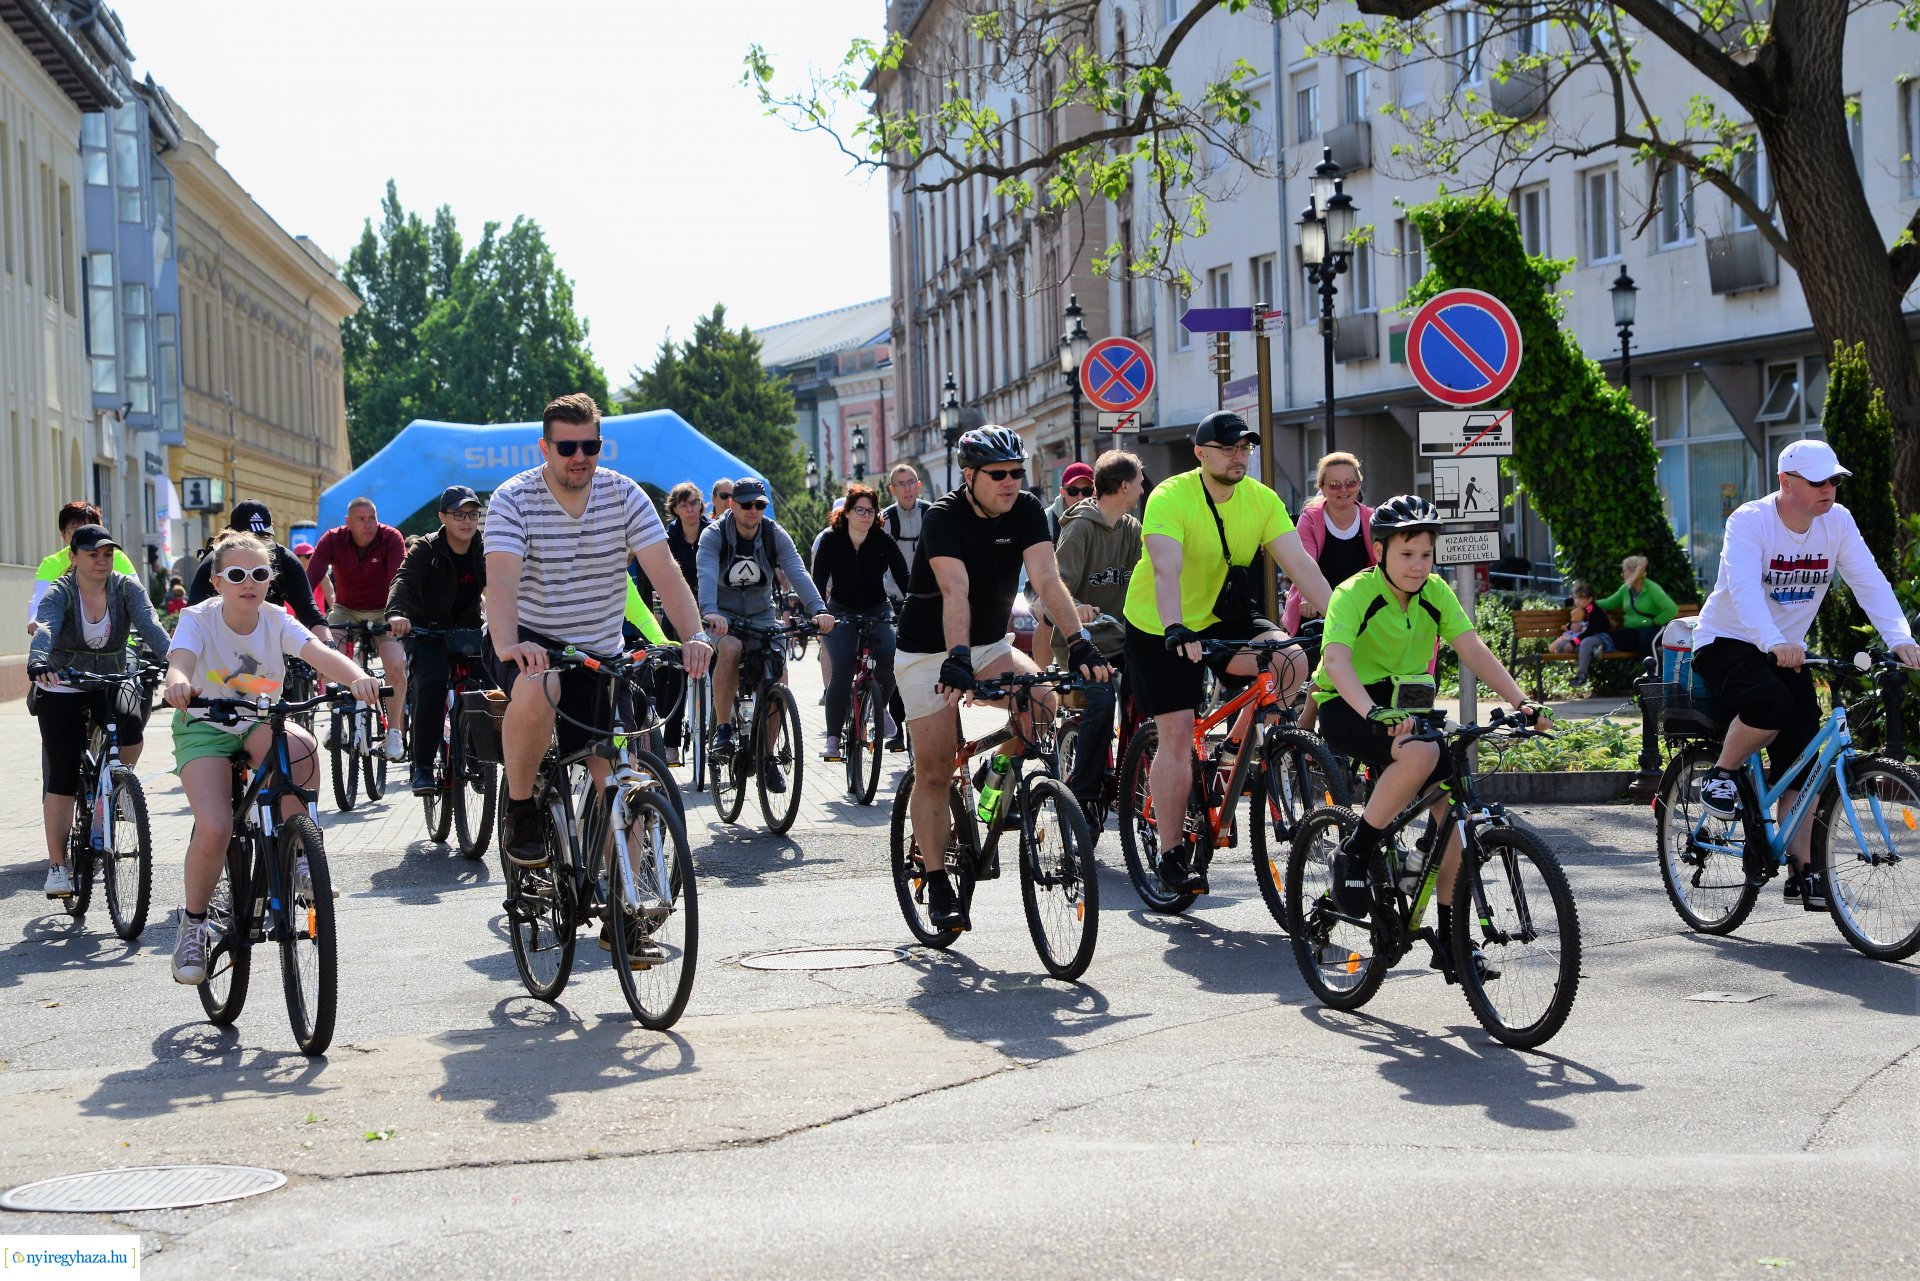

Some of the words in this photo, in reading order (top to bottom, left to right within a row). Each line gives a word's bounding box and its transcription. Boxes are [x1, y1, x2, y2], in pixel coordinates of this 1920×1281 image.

[464, 439, 619, 469] SHIMO
[1764, 570, 1829, 585] ATTITUDE
[1773, 586, 1816, 600] STYLE
[1790, 761, 1822, 815] Professional
[1345, 880, 1365, 888] PUMA
